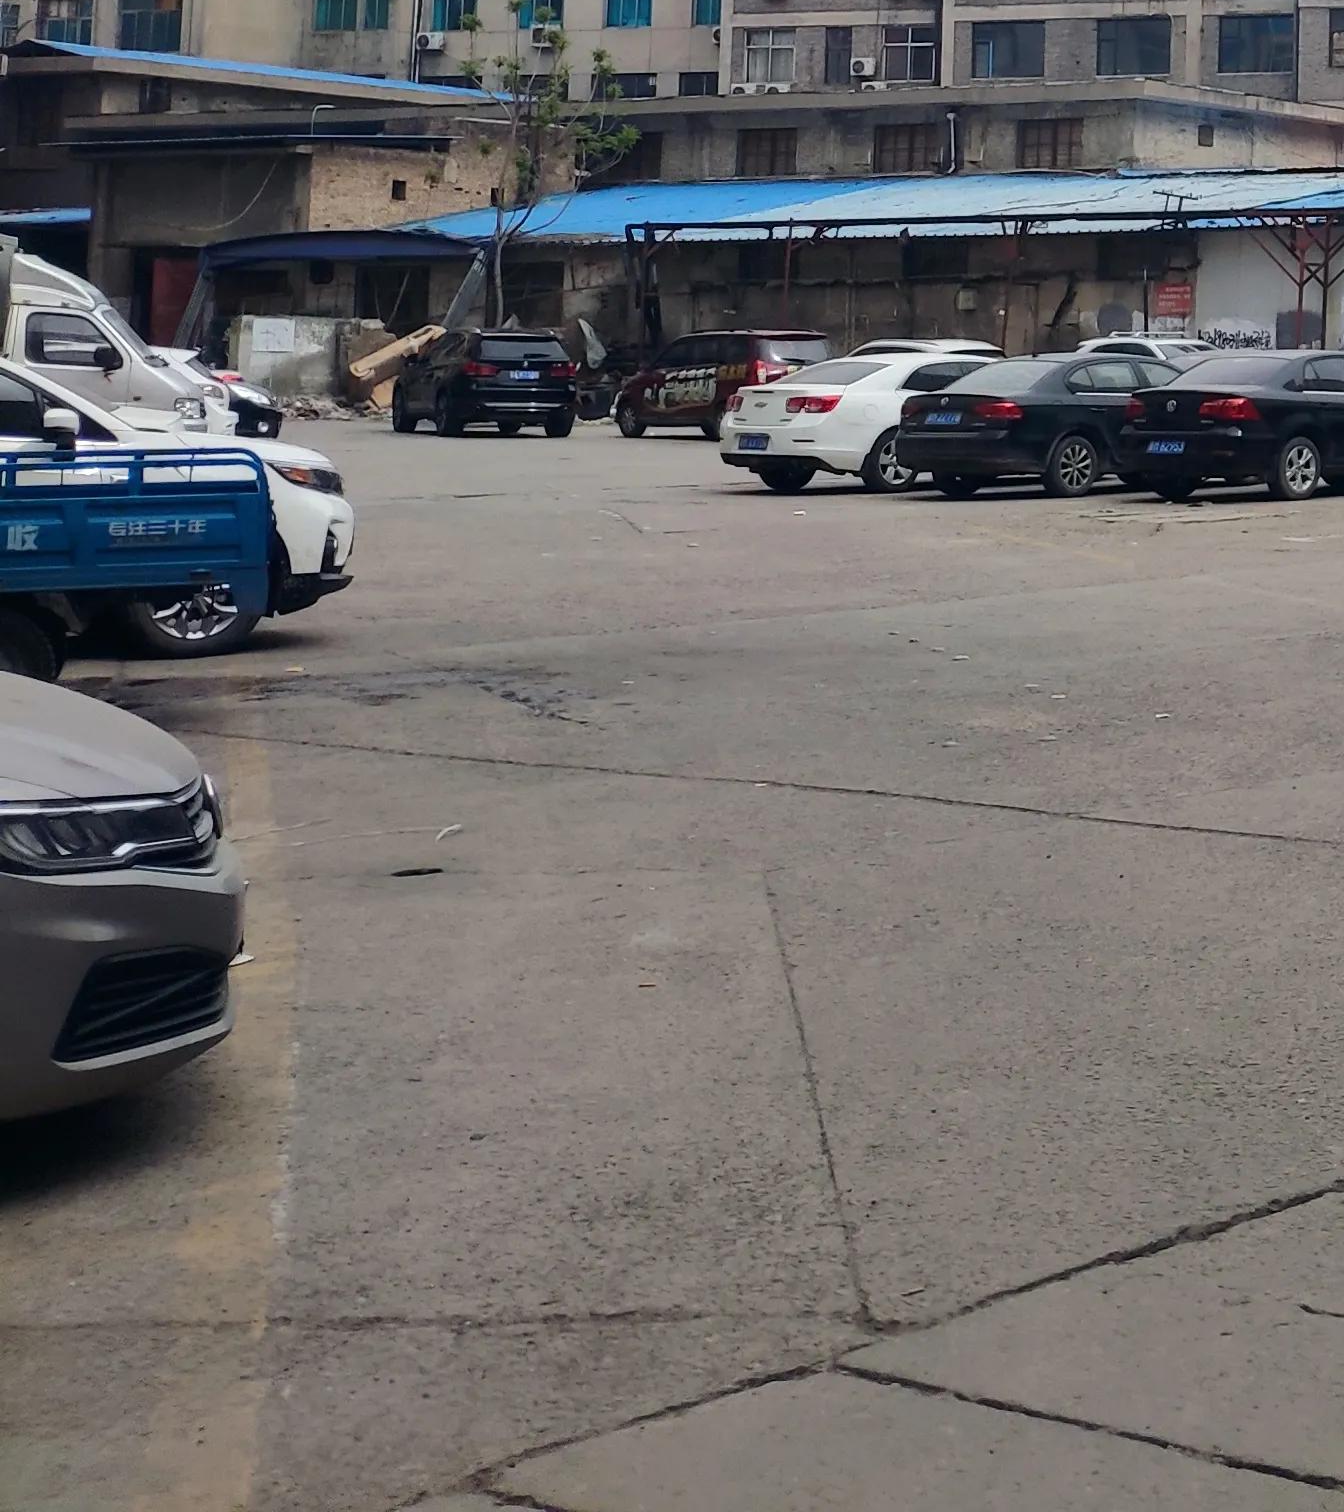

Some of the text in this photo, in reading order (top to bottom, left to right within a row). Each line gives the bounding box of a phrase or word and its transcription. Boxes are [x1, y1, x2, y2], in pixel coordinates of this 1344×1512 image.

[6, 524, 41, 551] 收
[108, 519, 208, 537] 专注三十年
